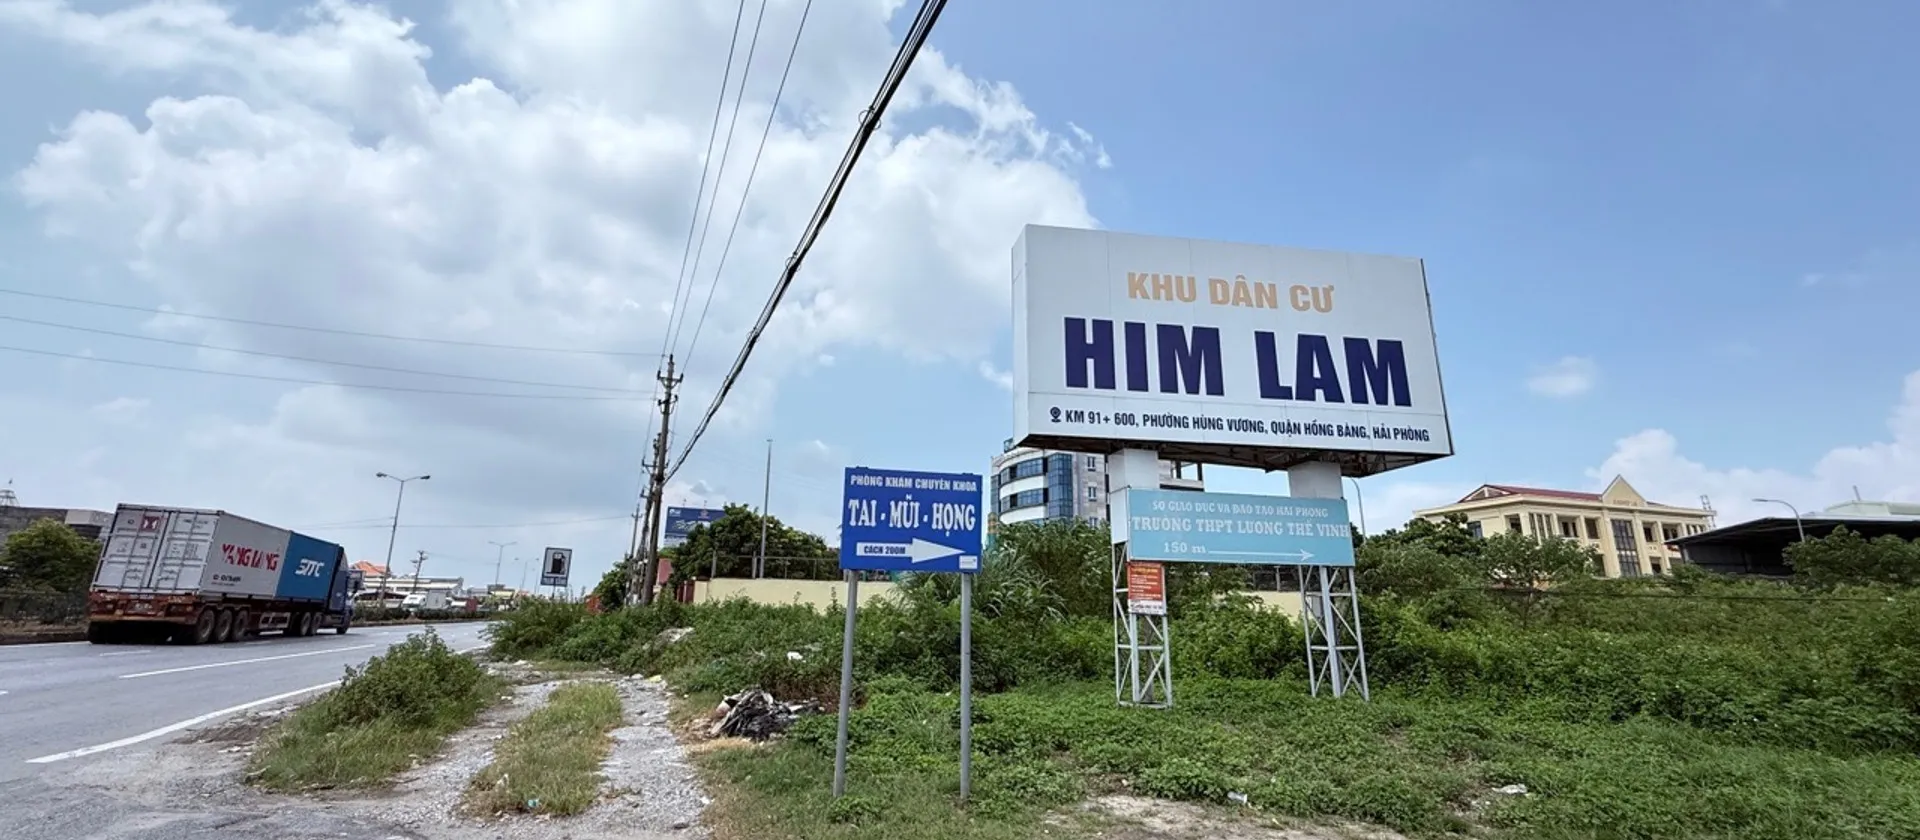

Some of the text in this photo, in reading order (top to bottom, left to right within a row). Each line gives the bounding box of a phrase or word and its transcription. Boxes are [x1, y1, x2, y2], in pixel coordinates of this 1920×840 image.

[1127, 272, 1336, 313] KHU DÂN CƯ
[1063, 316, 1412, 408] HIM LAM
[1065, 409, 1085, 424] KM
[1114, 412, 1139, 428] 600,
[1142, 412, 1189, 429] PHƯỜNG
[1192, 413, 1224, 431] HÙNG
[1270, 419, 1302, 438] QUẬN
[1372, 422, 1391, 440] HẢI
[1393, 425, 1430, 443] PHÒNG
[952, 480, 977, 492] KHOA
[848, 499, 877, 527] TAI
[888, 493, 920, 529] MŨI
[931, 502, 976, 537] HỌNG
[1195, 518, 1233, 534] THPT
[1316, 523, 1350, 538] VINH
[1164, 541, 1207, 554] 150 m
